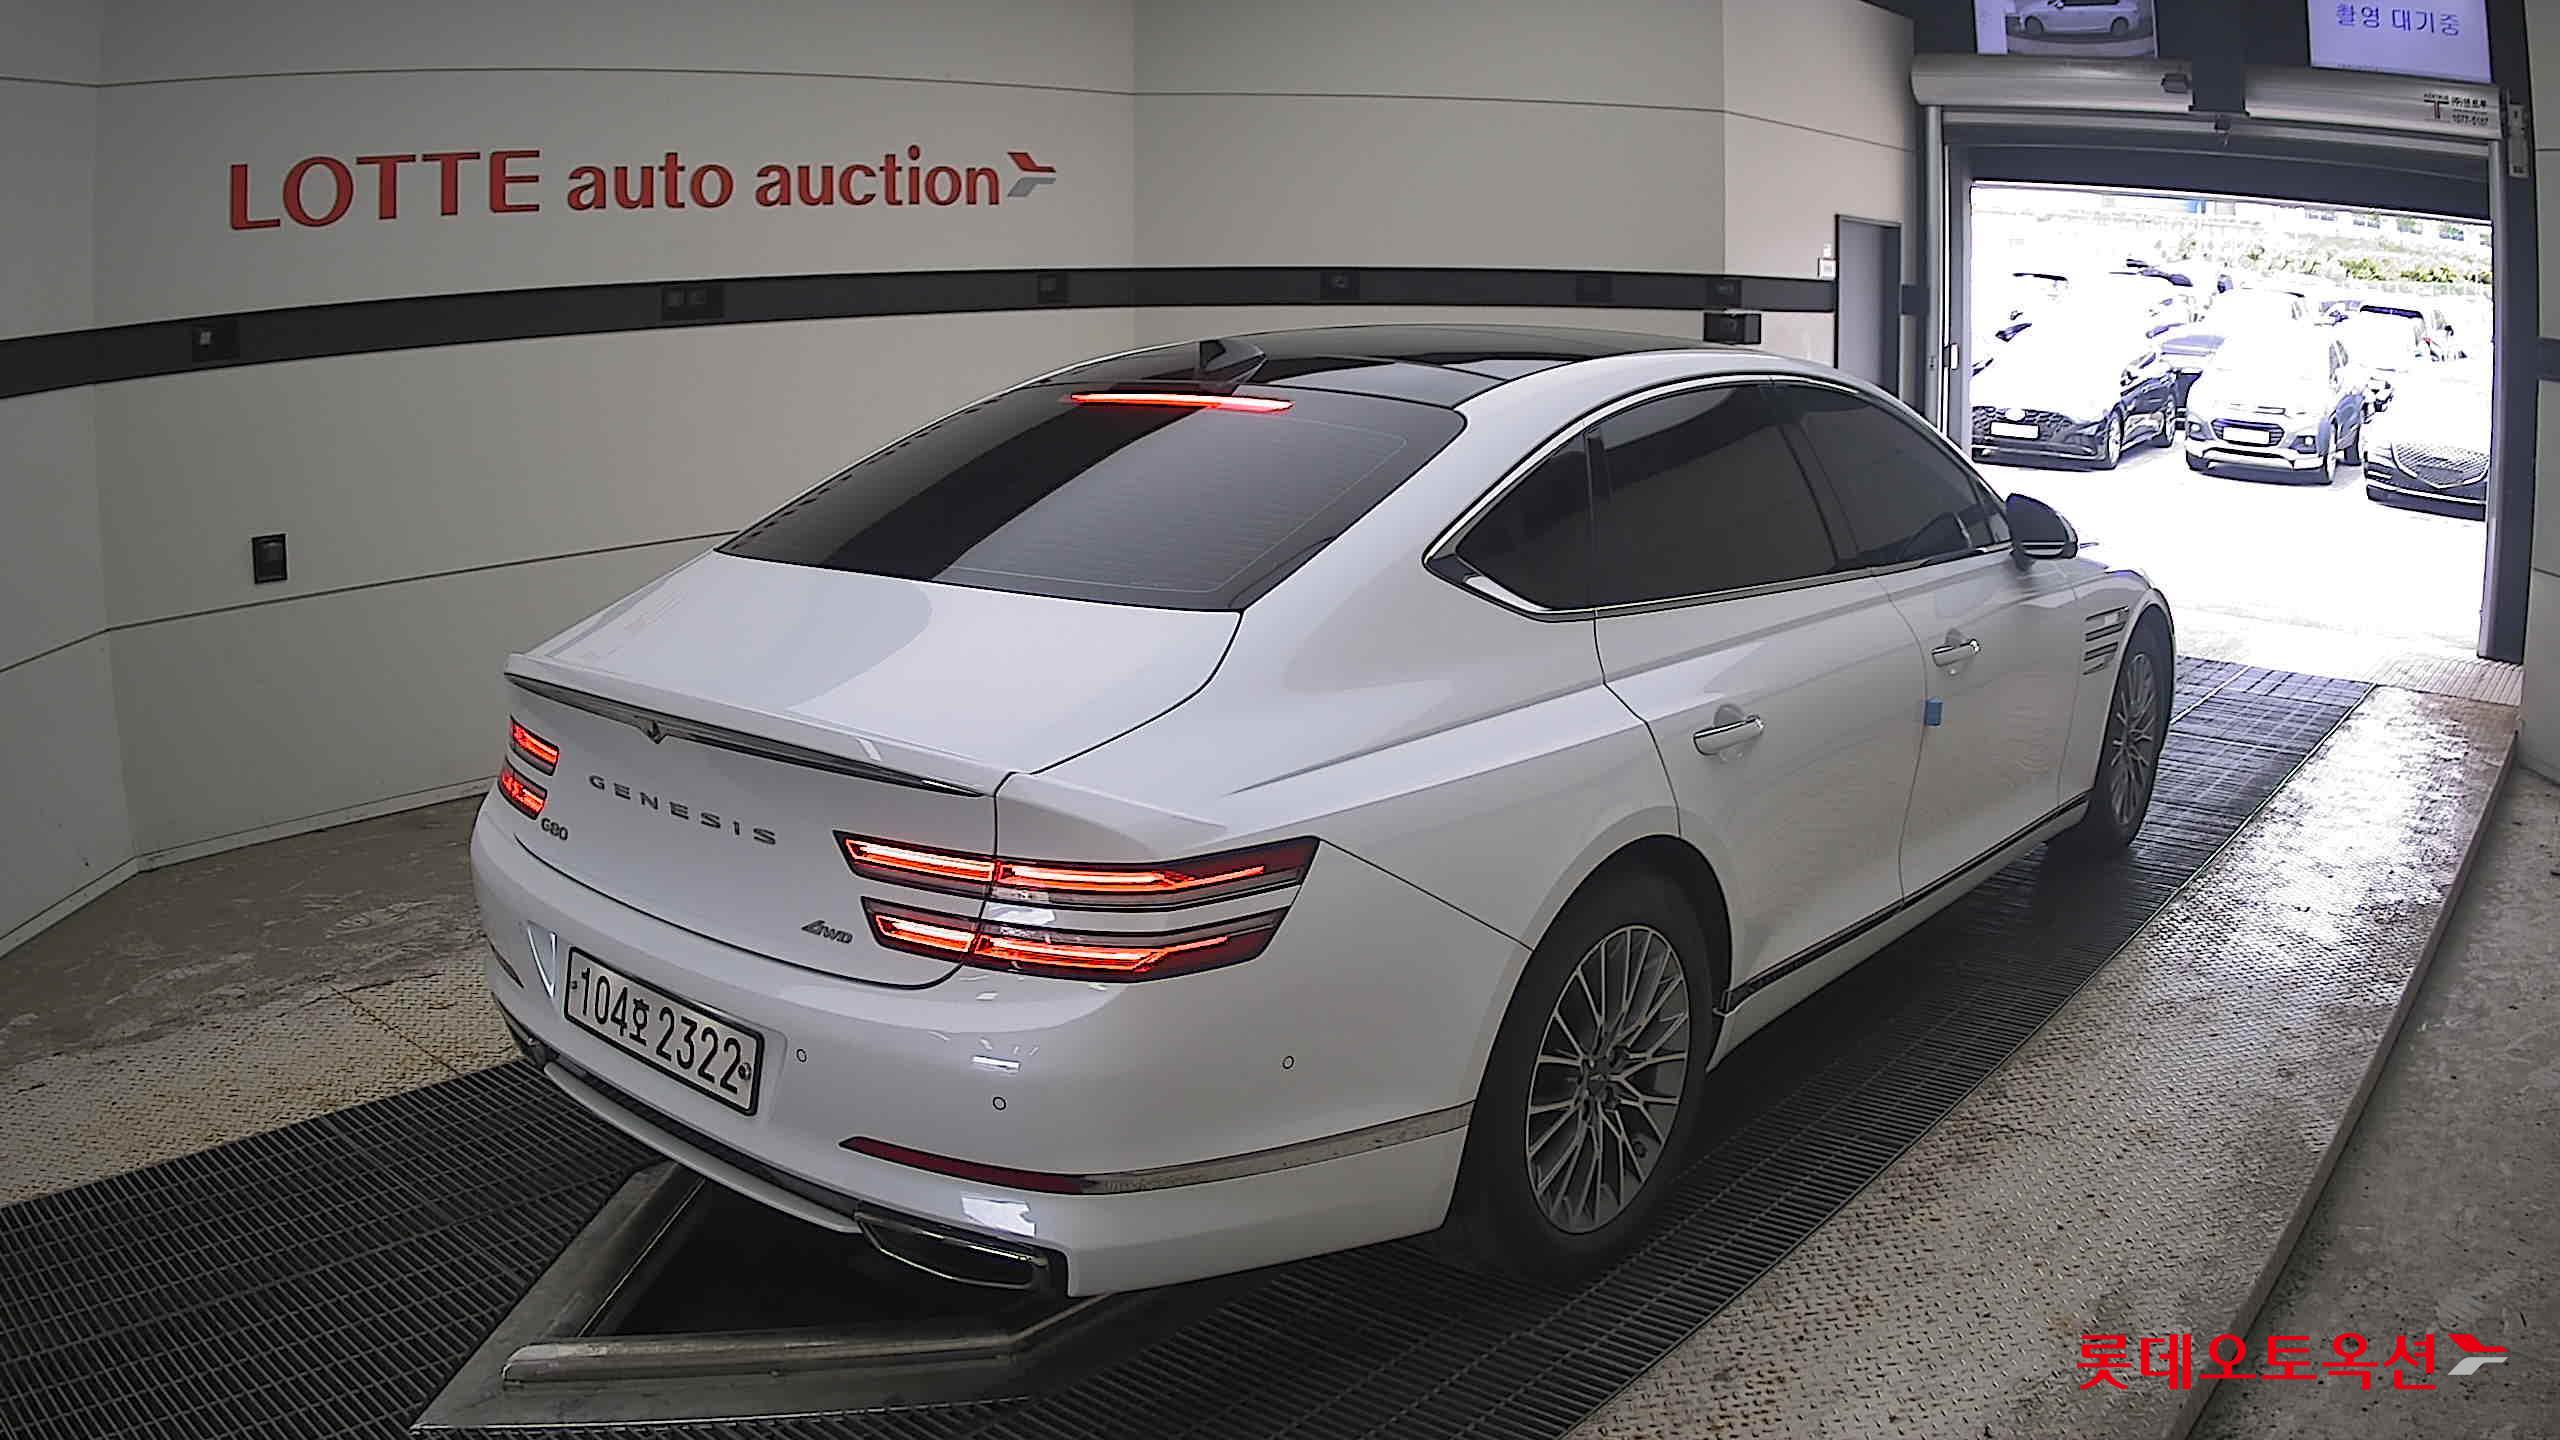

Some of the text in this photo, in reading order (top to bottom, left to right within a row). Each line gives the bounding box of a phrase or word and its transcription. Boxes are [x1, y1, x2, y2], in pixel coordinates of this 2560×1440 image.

[229, 145, 1001, 231] LOTTE auto auction
[540, 817, 569, 841] G80
[588, 774, 777, 846] GENESIS
